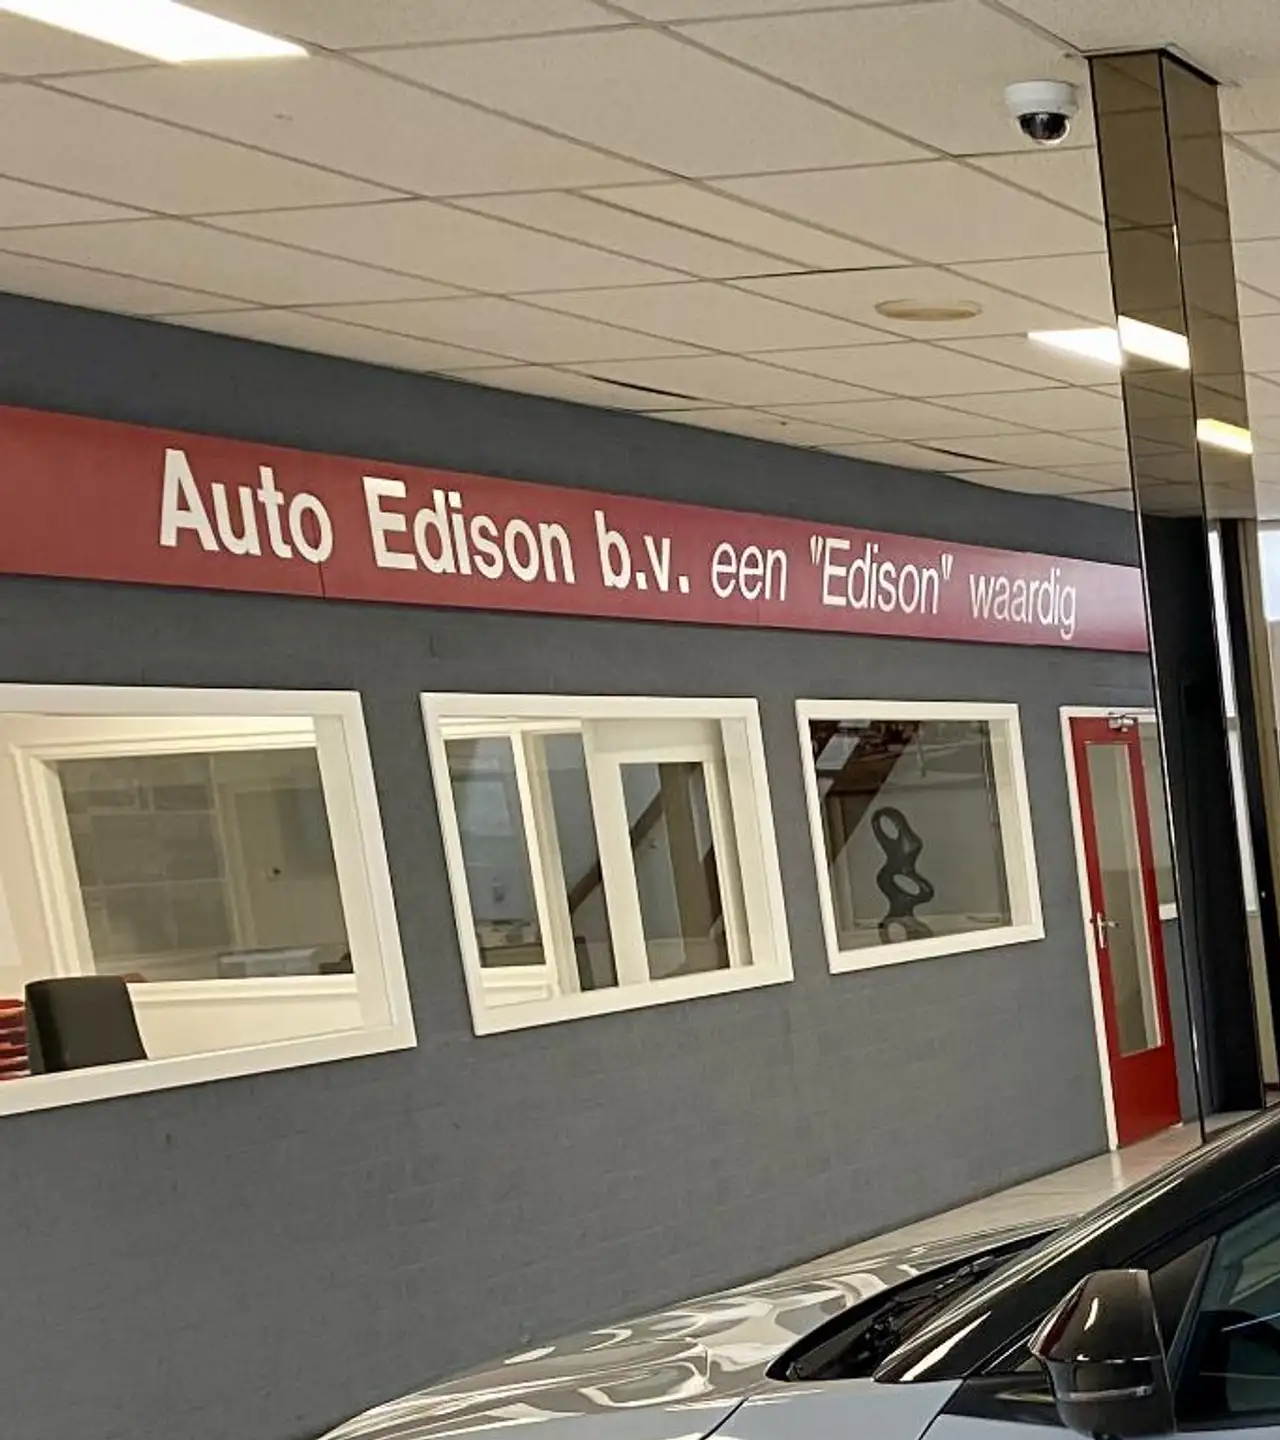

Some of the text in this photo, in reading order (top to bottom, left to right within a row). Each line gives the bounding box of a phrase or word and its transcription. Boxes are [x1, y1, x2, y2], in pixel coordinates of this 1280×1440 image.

[159, 448, 1077, 640] Auto Edison b.v. een "Edison" waardig
